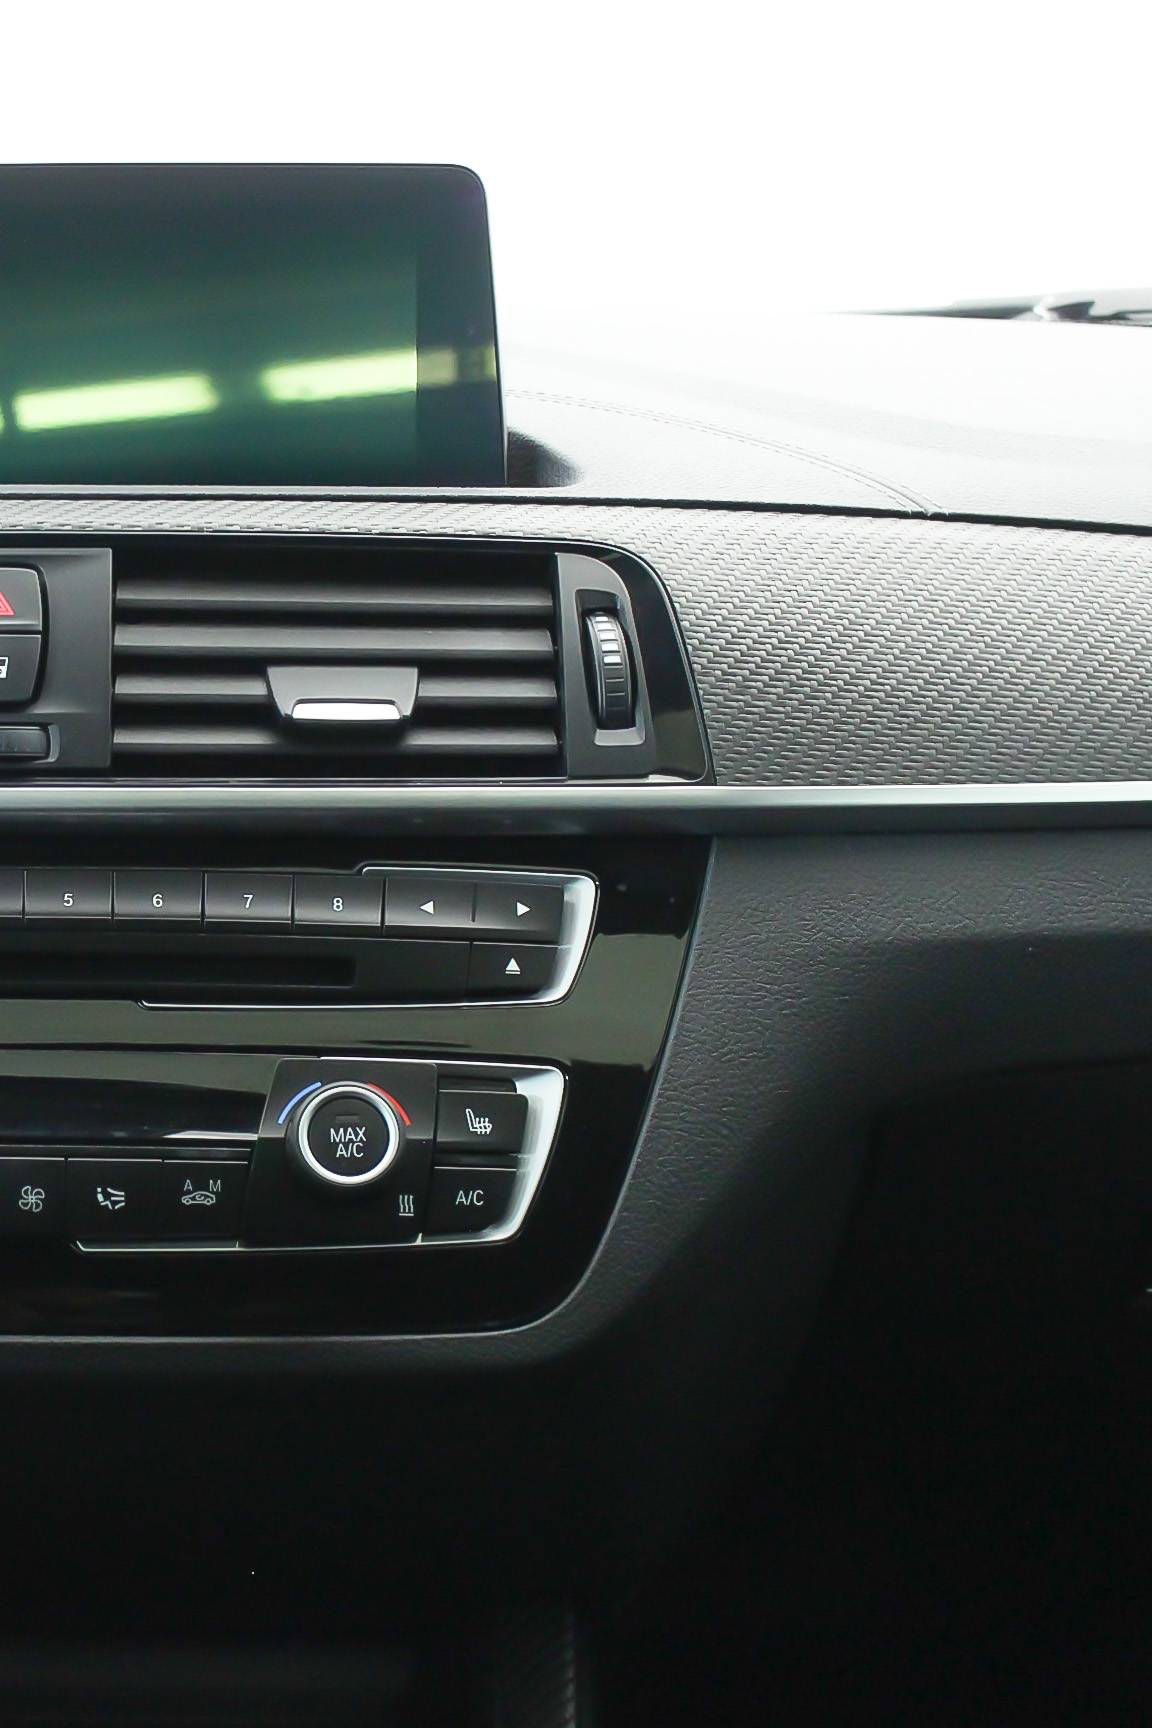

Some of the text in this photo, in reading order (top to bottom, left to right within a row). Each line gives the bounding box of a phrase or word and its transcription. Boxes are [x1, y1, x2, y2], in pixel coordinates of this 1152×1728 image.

[63, 893, 73, 908] 5
[152, 893, 163, 908] 6
[243, 894, 254, 909] 7
[332, 897, 344, 912] 8
[330, 1127, 367, 1144] MAX
[335, 1143, 364, 1159] A/C
[183, 1179, 194, 1192] A
[209, 1179, 222, 1192] M
[455, 1189, 485, 1207] A/C
